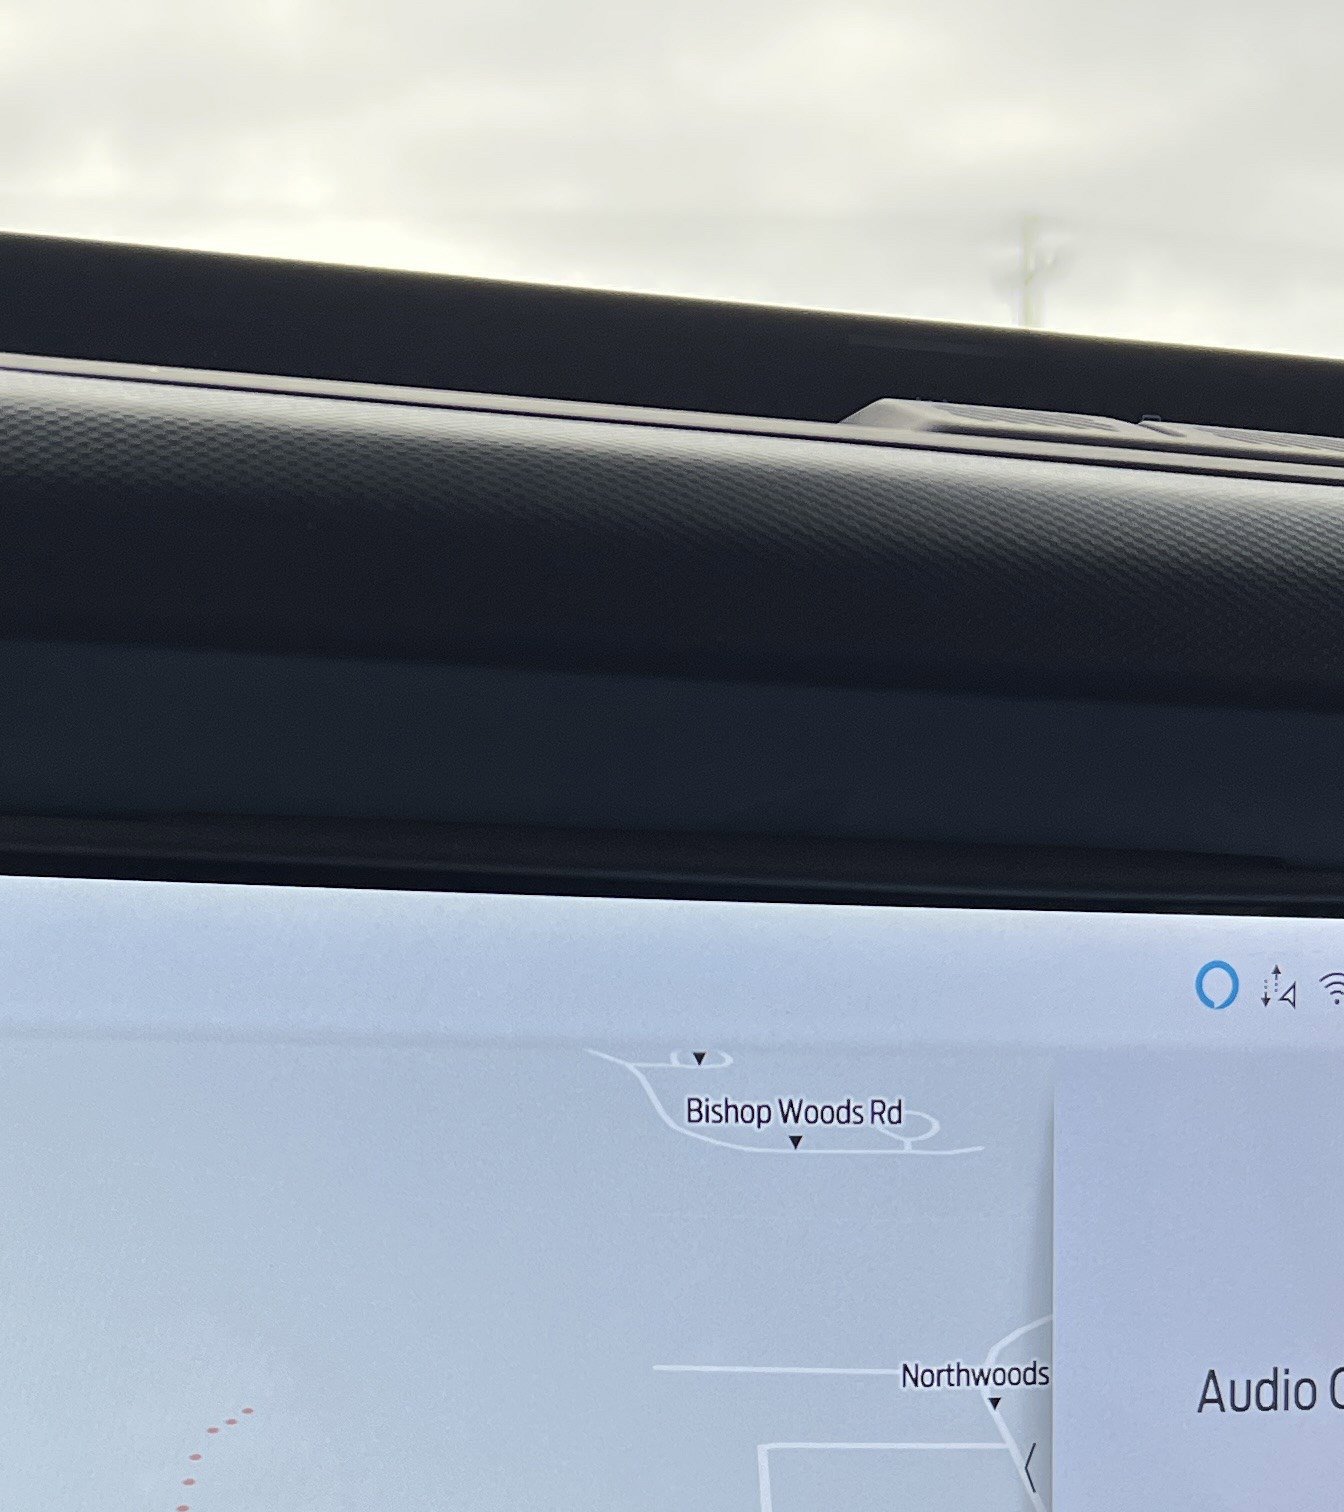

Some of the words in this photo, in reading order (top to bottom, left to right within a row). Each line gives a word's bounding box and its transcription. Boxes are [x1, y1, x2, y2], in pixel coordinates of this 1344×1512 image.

[686, 1096, 773, 1130] Bishop
[778, 1097, 865, 1126] Woods
[870, 1099, 903, 1126] Rd
[901, 1359, 1051, 1389] Northwoods
[1196, 1366, 1318, 1414] Audio
